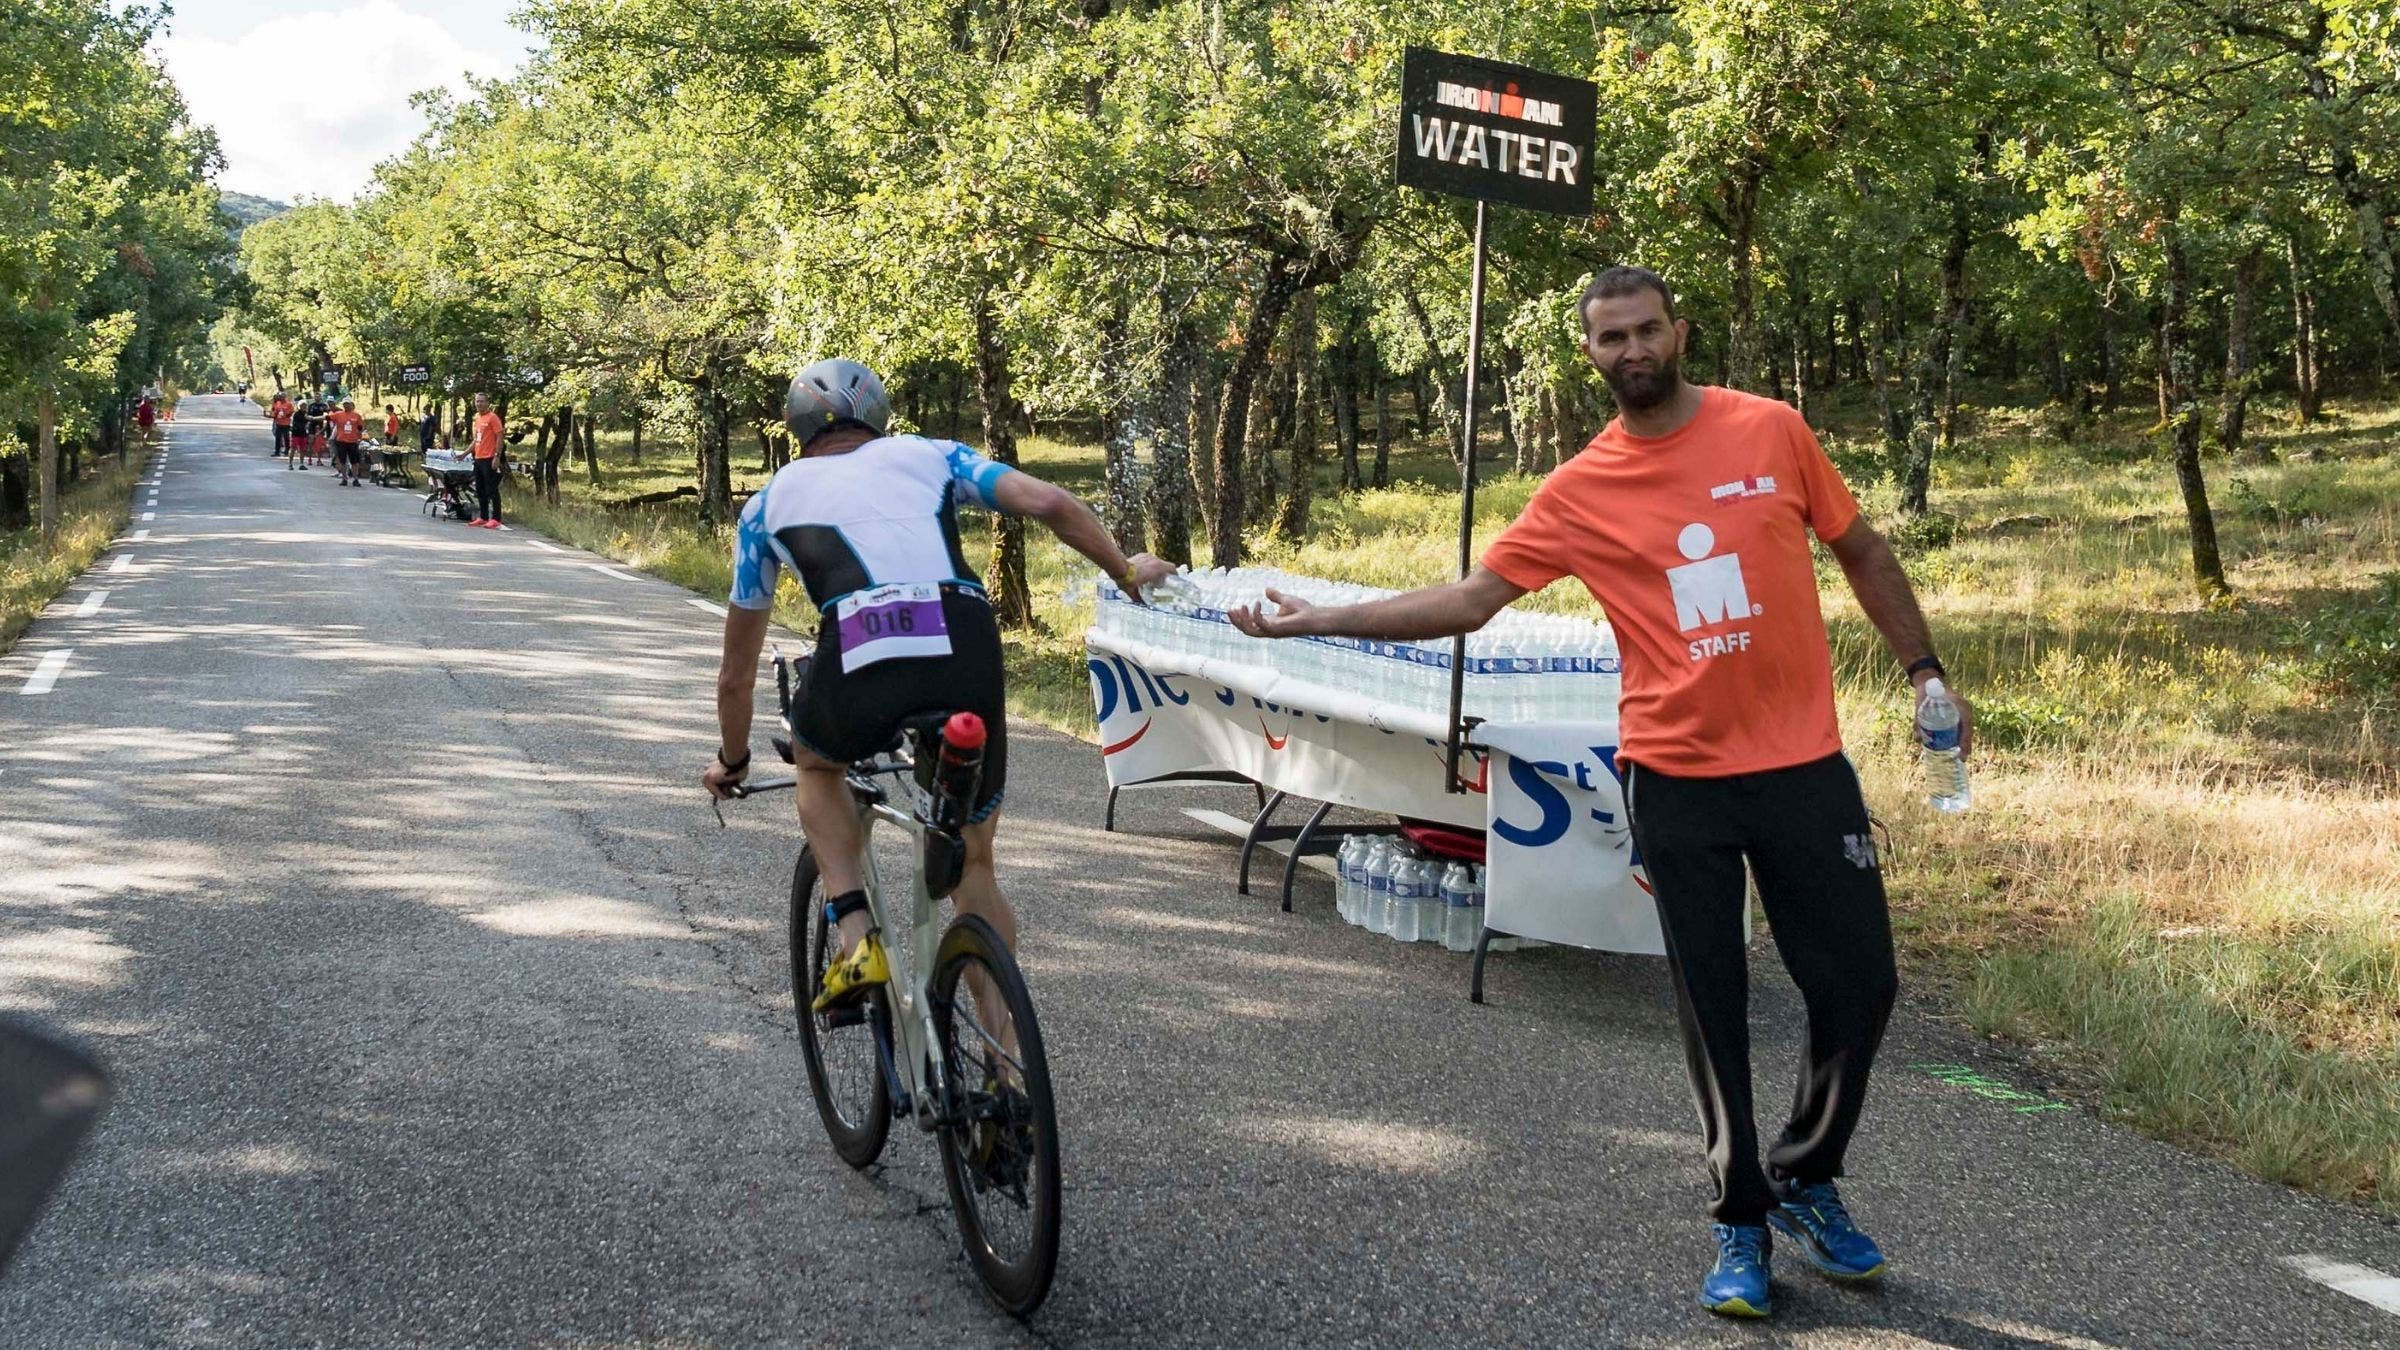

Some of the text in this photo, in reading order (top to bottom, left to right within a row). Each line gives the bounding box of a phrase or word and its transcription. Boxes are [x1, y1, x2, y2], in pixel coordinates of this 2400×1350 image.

[1412, 113, 1577, 185] WATER
[403, 371, 429, 382] FOOD
[864, 607, 914, 636] 016
[1688, 631, 1751, 661] STAFF
